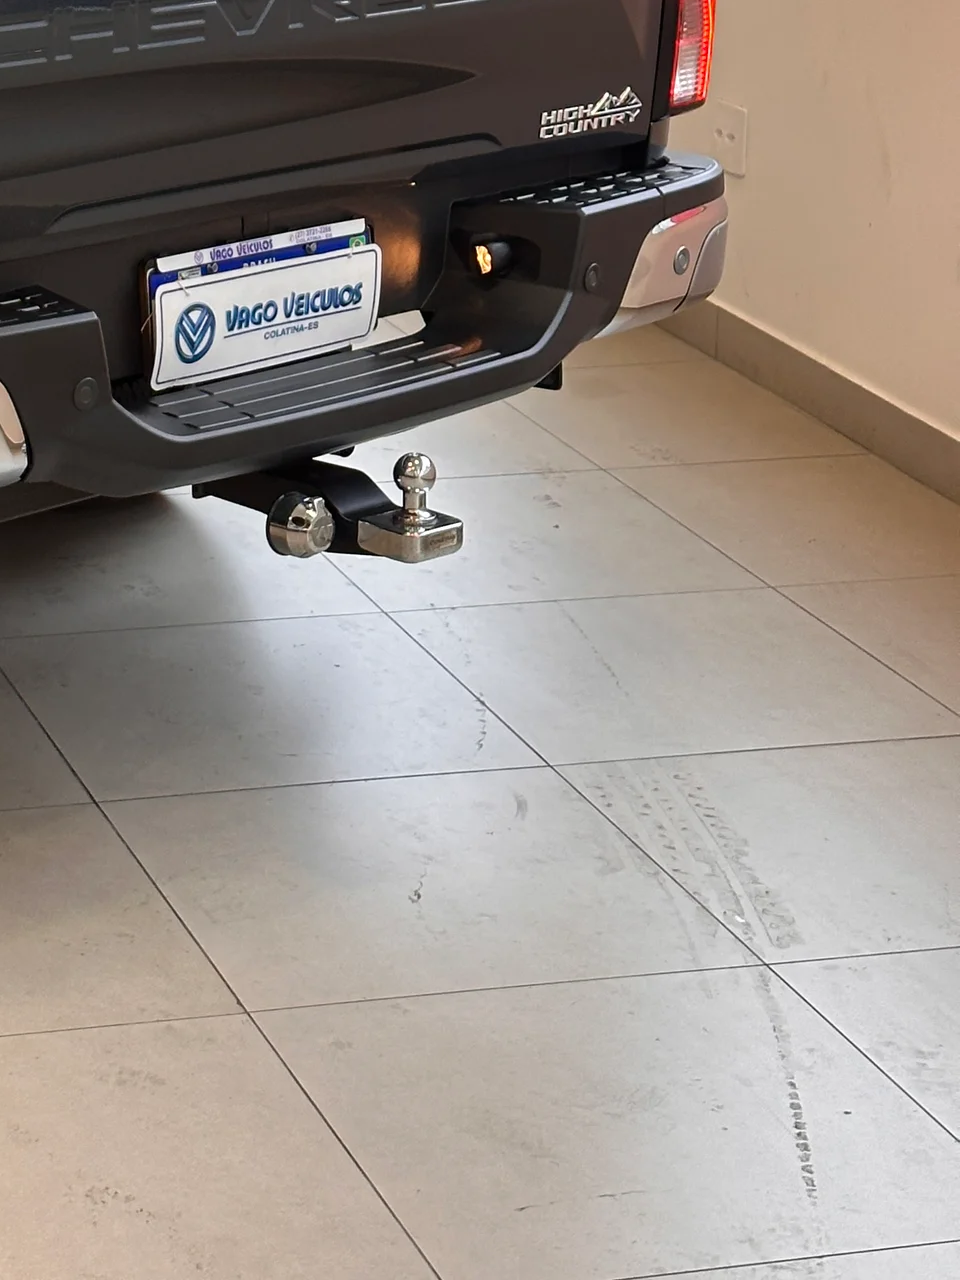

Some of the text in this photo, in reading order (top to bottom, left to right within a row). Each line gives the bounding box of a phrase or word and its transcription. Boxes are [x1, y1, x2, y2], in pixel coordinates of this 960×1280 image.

[540, 108, 640, 139] COUNTRY
[541, 103, 594, 126] HIGH
[210, 247, 233, 261] VAGO
[226, 282, 363, 332] VAGO VEICULOS
[264, 321, 319, 340] COLATINA-ES
